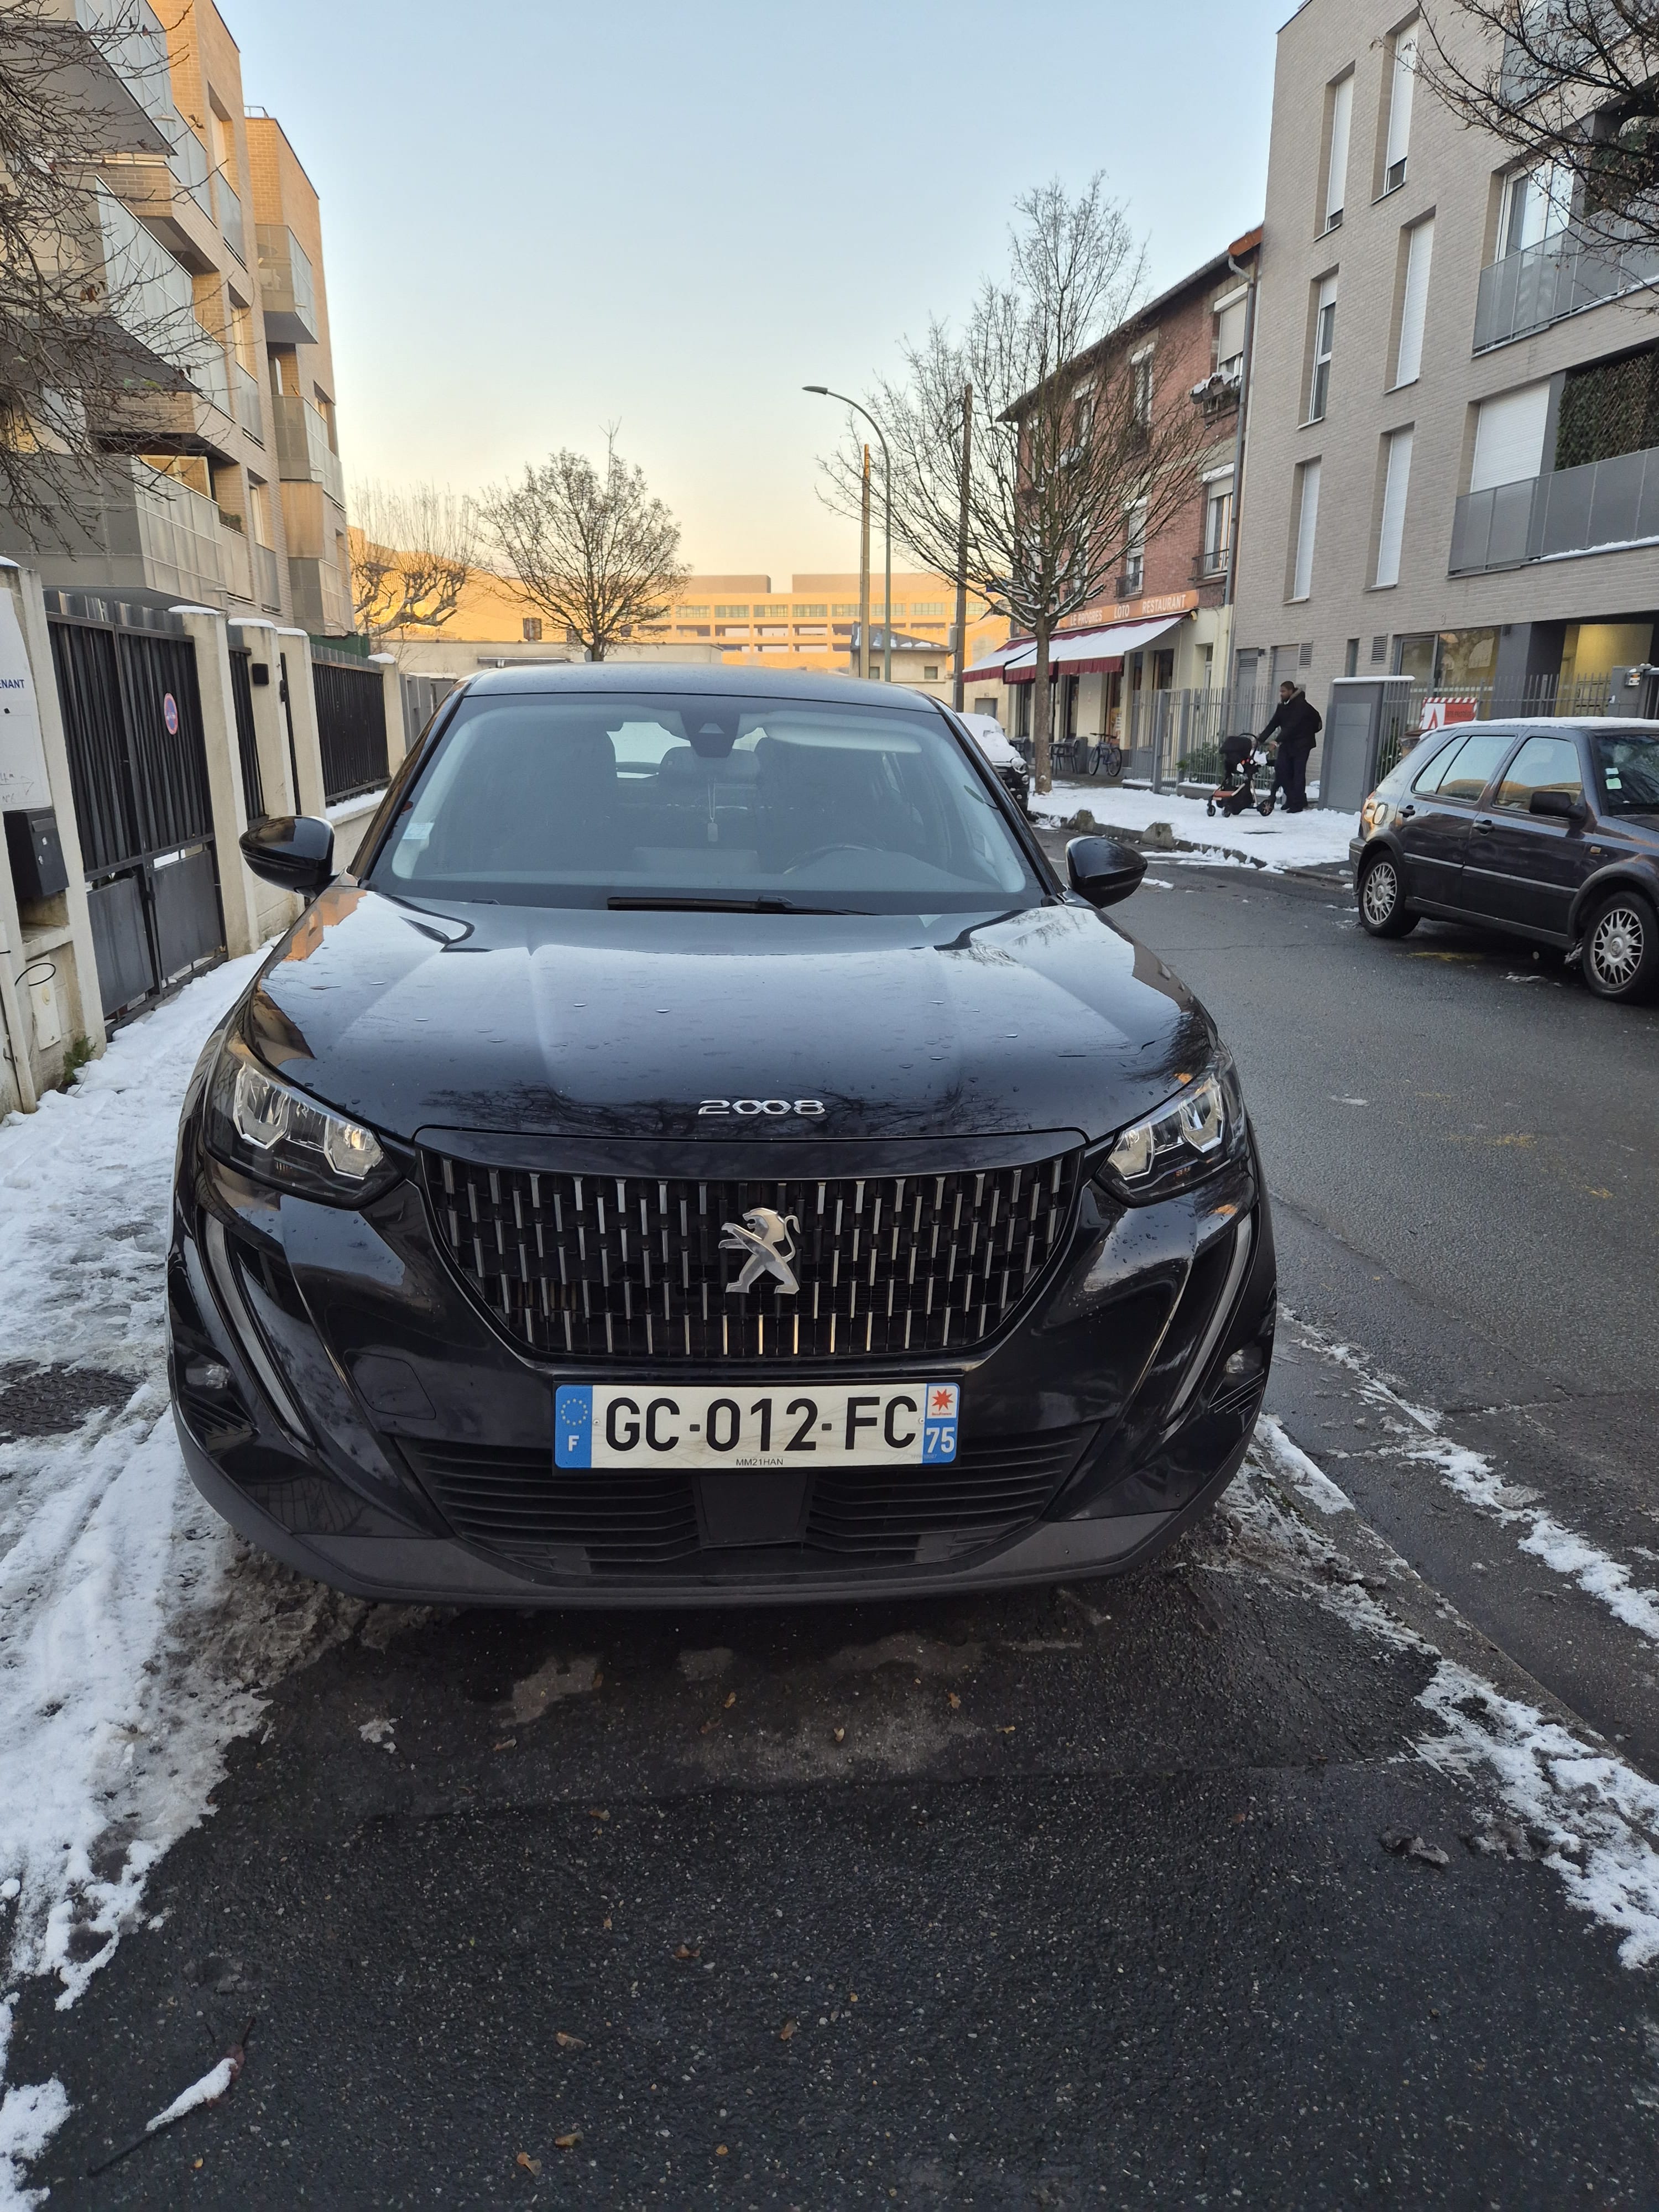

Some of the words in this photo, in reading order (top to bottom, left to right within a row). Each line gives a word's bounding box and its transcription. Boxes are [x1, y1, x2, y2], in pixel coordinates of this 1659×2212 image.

[1070, 614, 1077, 626] LE
[1114, 604, 1130, 619] LOTO
[1142, 594, 1186, 614] RESTAURANT
[698, 1100, 826, 1115] 2008
[606, 1396, 917, 1452] GC-012-FC
[568, 1435, 579, 1452] F
[926, 1427, 955, 1454] 75
